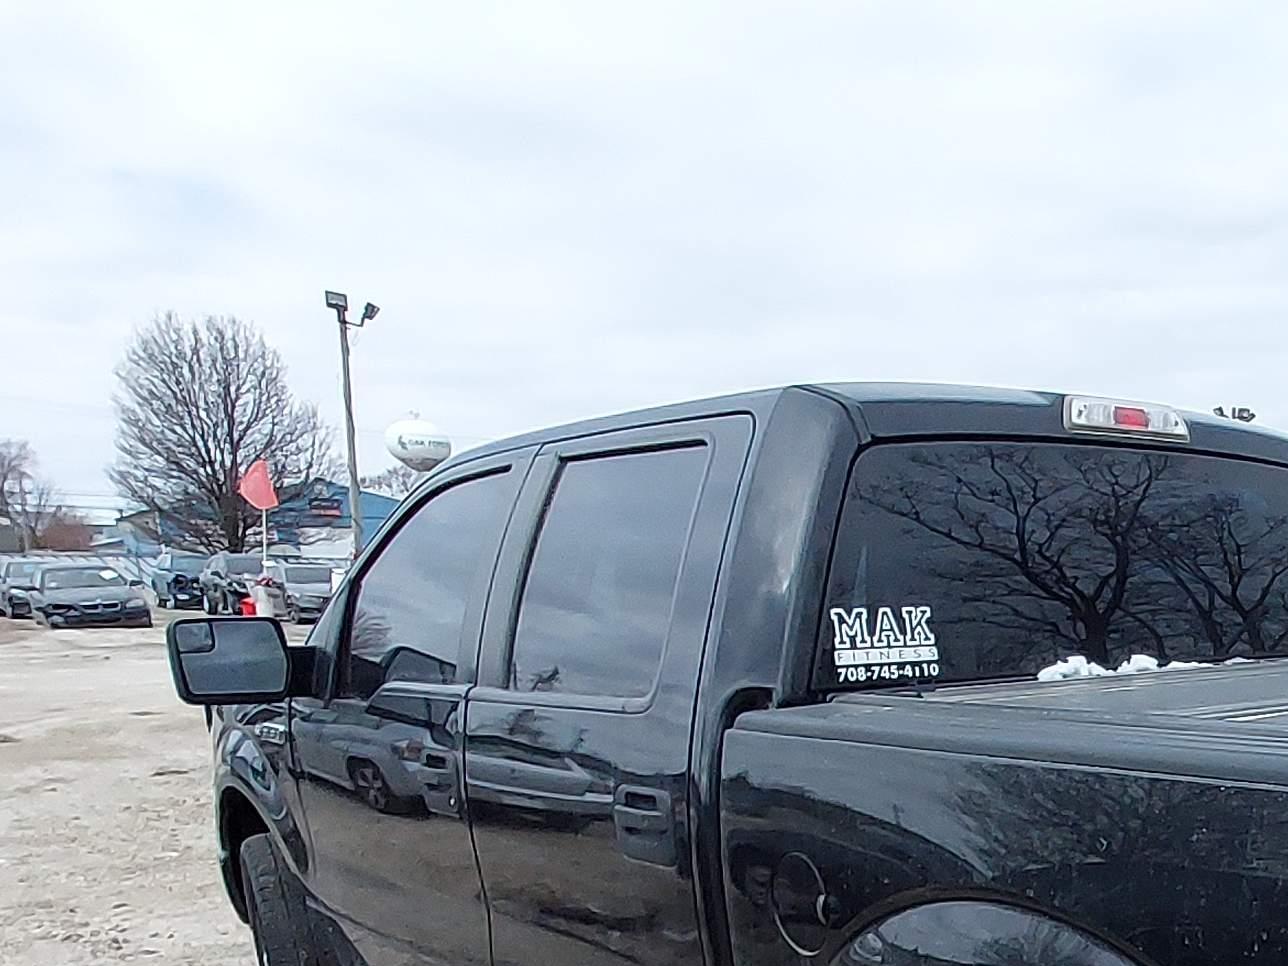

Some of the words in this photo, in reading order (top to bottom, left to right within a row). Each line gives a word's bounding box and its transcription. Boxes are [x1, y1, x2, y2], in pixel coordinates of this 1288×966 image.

[830, 606, 935, 648] MAK
[836, 648, 937, 664] FITNESS
[837, 663, 939, 682] 708-745-4110
